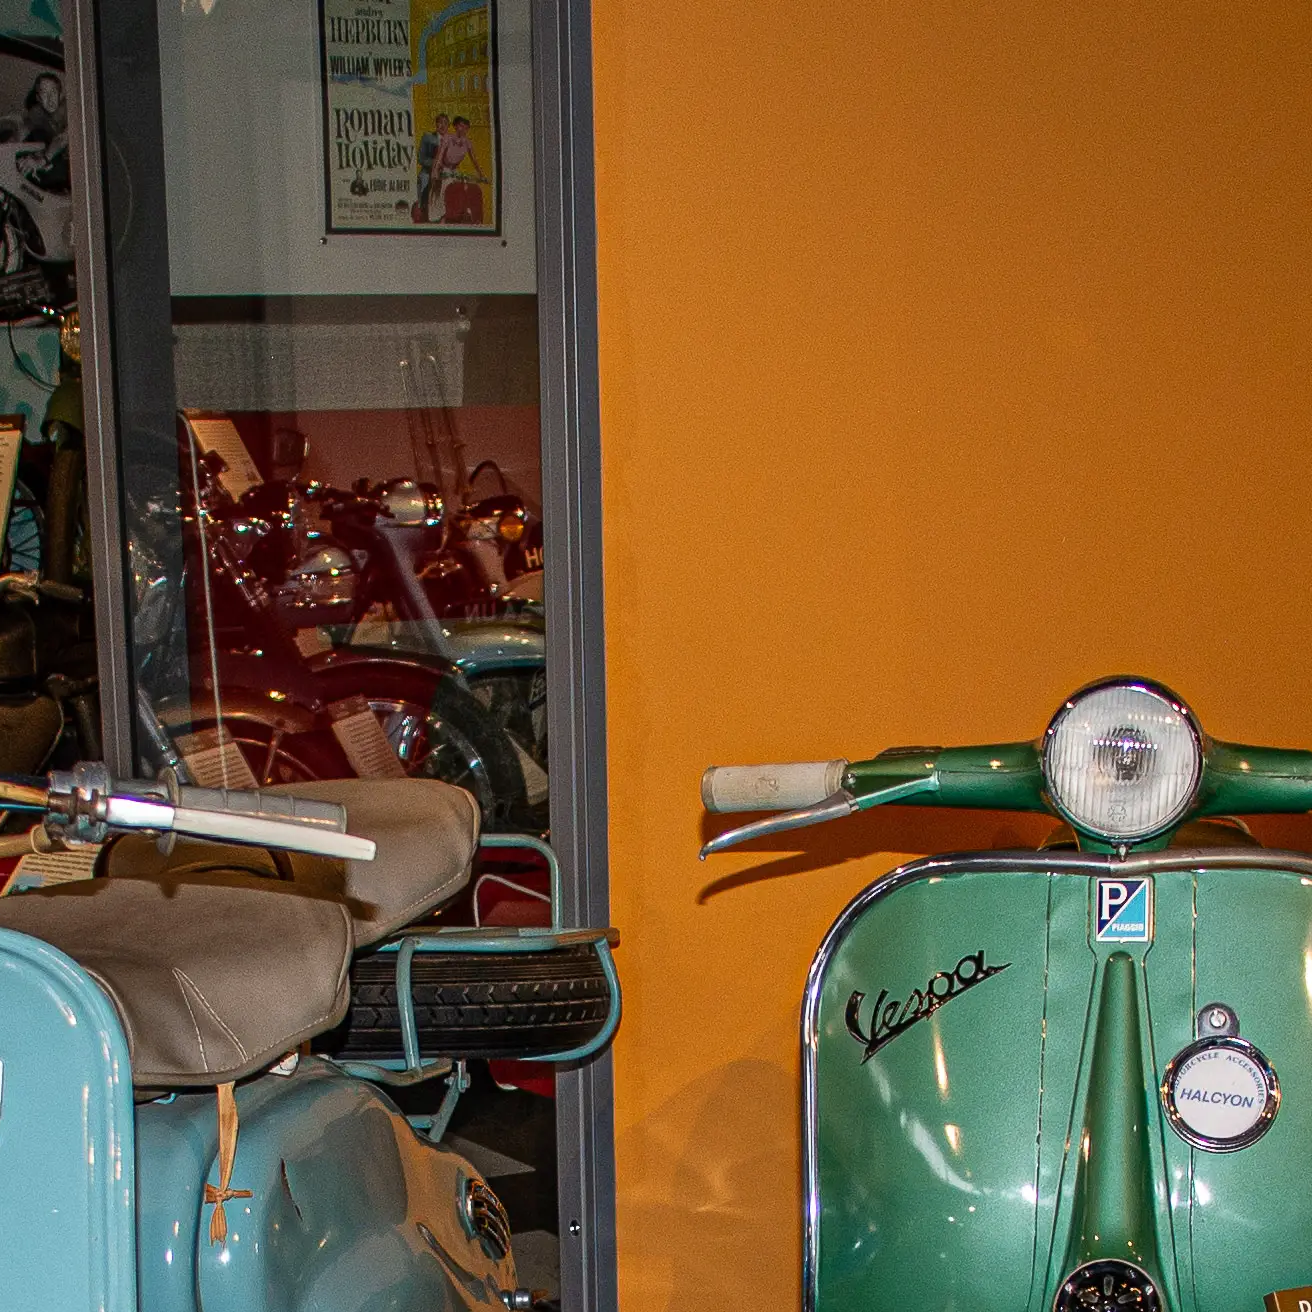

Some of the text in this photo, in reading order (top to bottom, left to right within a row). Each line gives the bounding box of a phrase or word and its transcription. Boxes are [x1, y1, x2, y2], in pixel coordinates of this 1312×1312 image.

[330, 16, 410, 47] HEPBURN
[330, 55, 412, 78] WILLIAM WYLER'S
[334, 107, 414, 143] Roman
[336, 140, 415, 172] Holiday
[1101, 883, 1128, 920] P
[1112, 923, 1144, 932] PIAGGIO
[845, 949, 1013, 1066] Vespa
[1179, 1088, 1255, 1108] HALCYON
